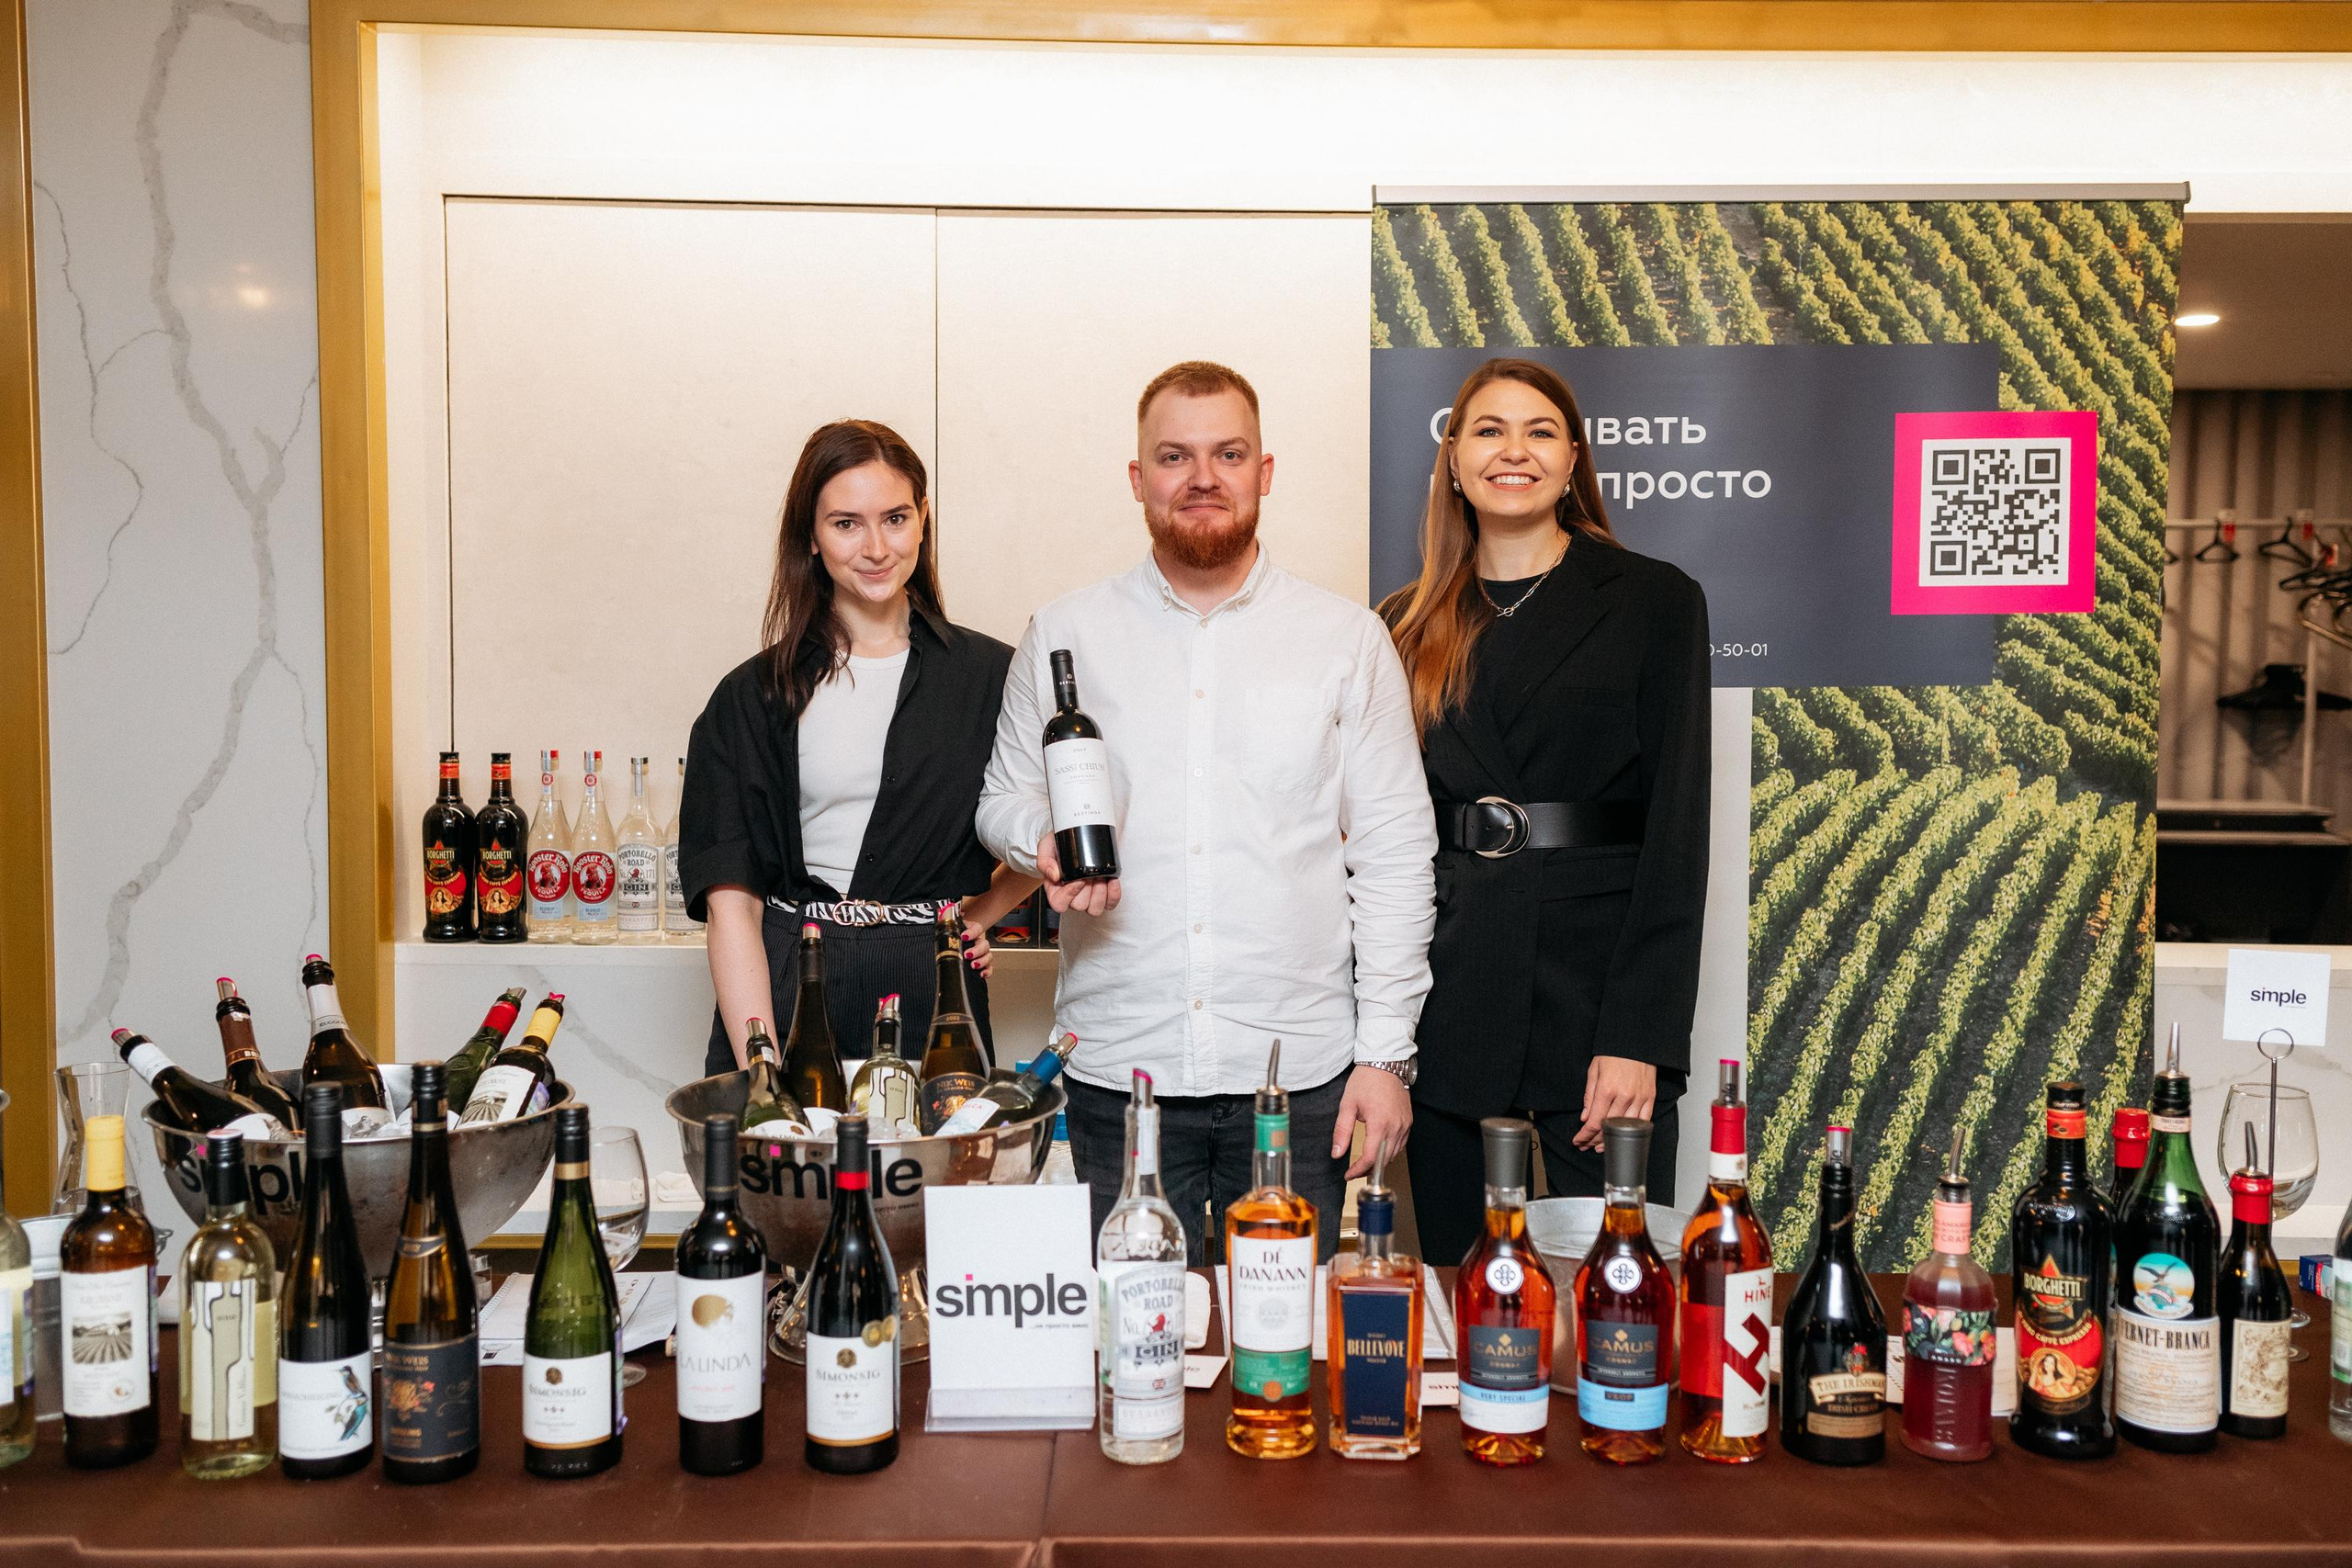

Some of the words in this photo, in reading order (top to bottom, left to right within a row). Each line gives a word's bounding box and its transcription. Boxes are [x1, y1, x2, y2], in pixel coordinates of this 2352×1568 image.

[1600, 470, 1772, 509] просто
[426, 850, 455, 860] BORGHETTI
[482, 850, 512, 860] BORGHETTI
[618, 850, 656, 862] PORTOBELLO
[625, 884, 647, 892] GIN
[2250, 987, 2307, 1007] simple
[178, 1145, 305, 1215] sipl
[741, 1145, 922, 1200] simle
[1263, 1246, 1281, 1264] DÉ
[1239, 1266, 1306, 1281] DANANN
[2023, 1272, 2081, 1297] BORGHETTI
[935, 1273, 1088, 1328] simple
[1144, 1294, 1173, 1311] ROAD
[1744, 1287, 1771, 1303] HINE
[1140, 1342, 1178, 1359] GIN
[1347, 1338, 1406, 1358] BELLEVOYE
[1474, 1342, 1537, 1358] CAMUS
[1591, 1336, 1655, 1354] CAMUS
[1818, 1381, 1838, 1392] THE
